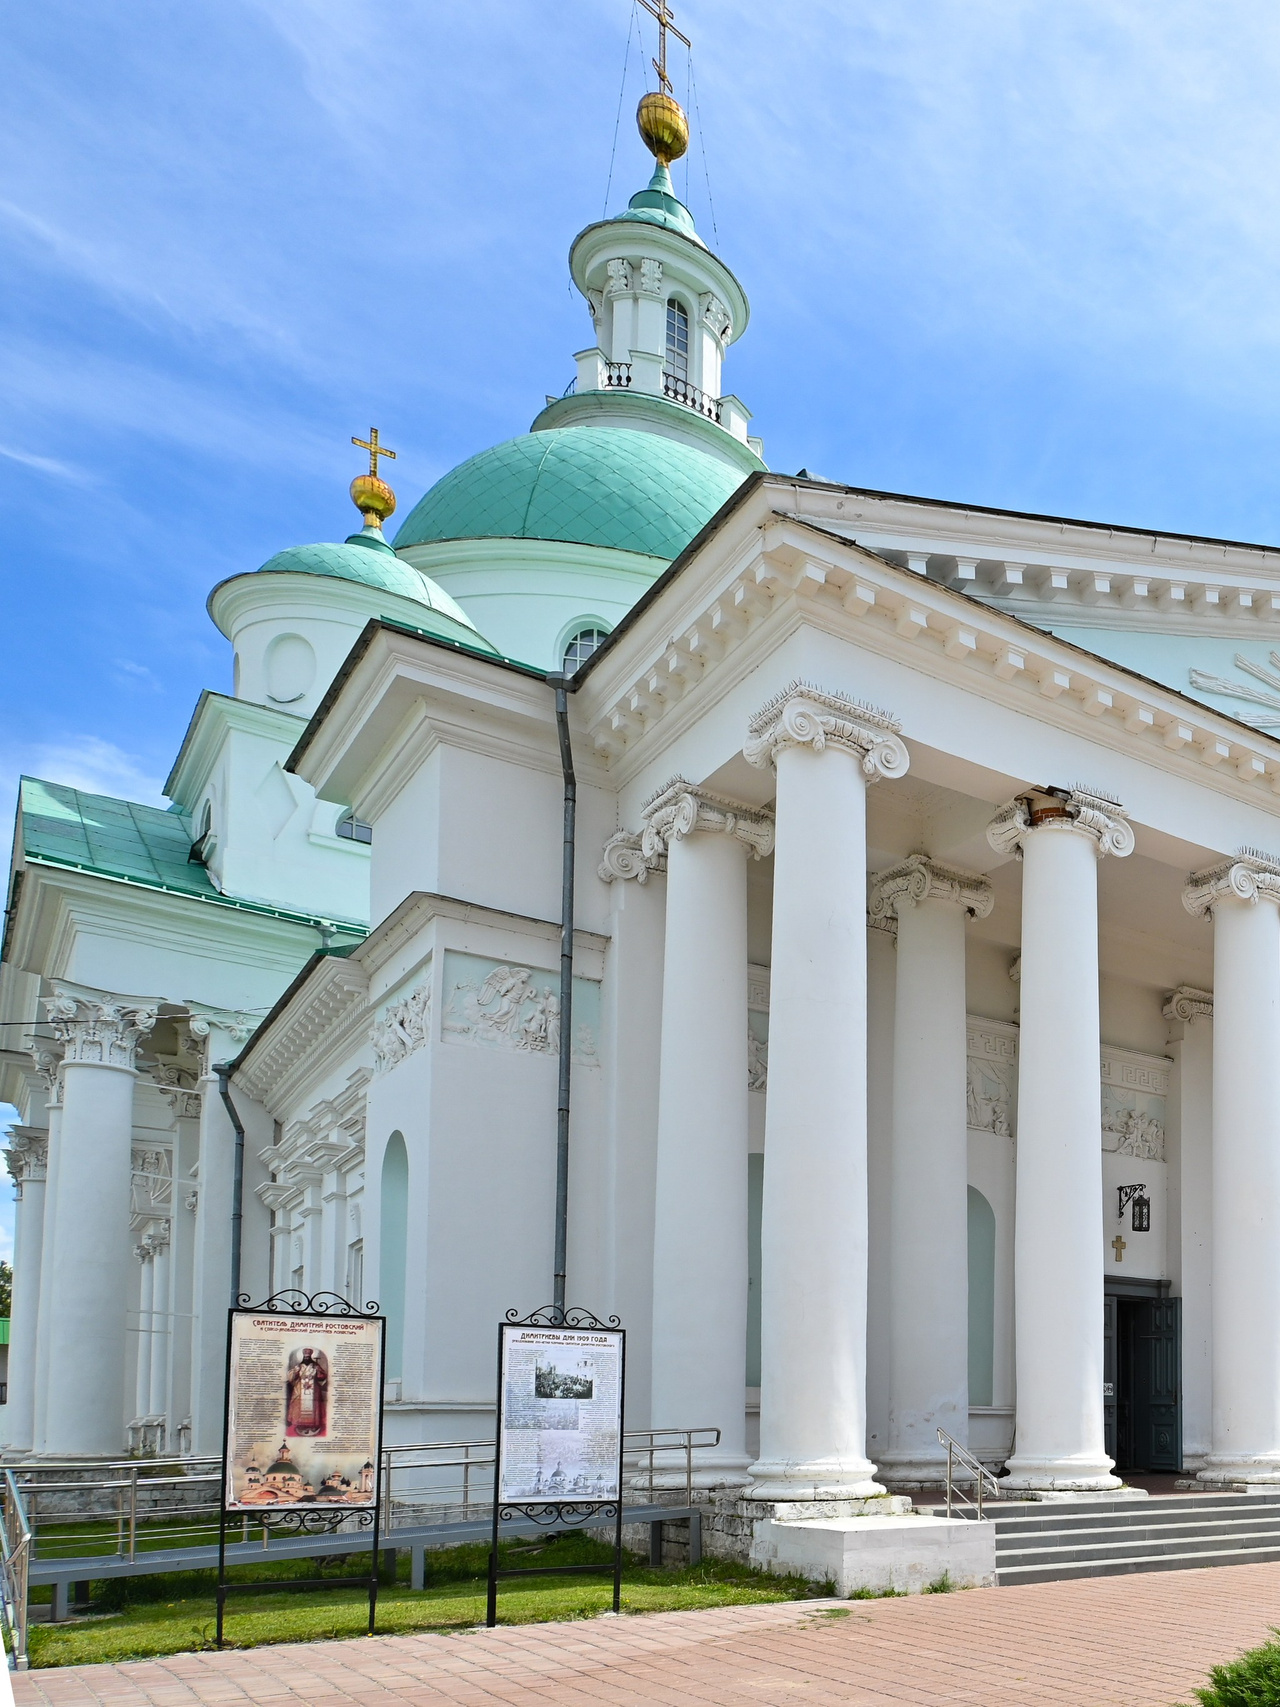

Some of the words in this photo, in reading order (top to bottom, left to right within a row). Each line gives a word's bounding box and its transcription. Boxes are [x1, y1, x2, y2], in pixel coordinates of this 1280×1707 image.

[252, 1319, 288, 1327] СВЯТИТЕЛЬ
[290, 1321, 324, 1329] ДИМИТРИЙ
[325, 1323, 365, 1331] РОСТОВСКИЙ
[520, 1332, 560, 1340] ДИМИТРИЕВЫ
[562, 1333, 575, 1341] ДНИ
[577, 1334, 589, 1342] 1909
